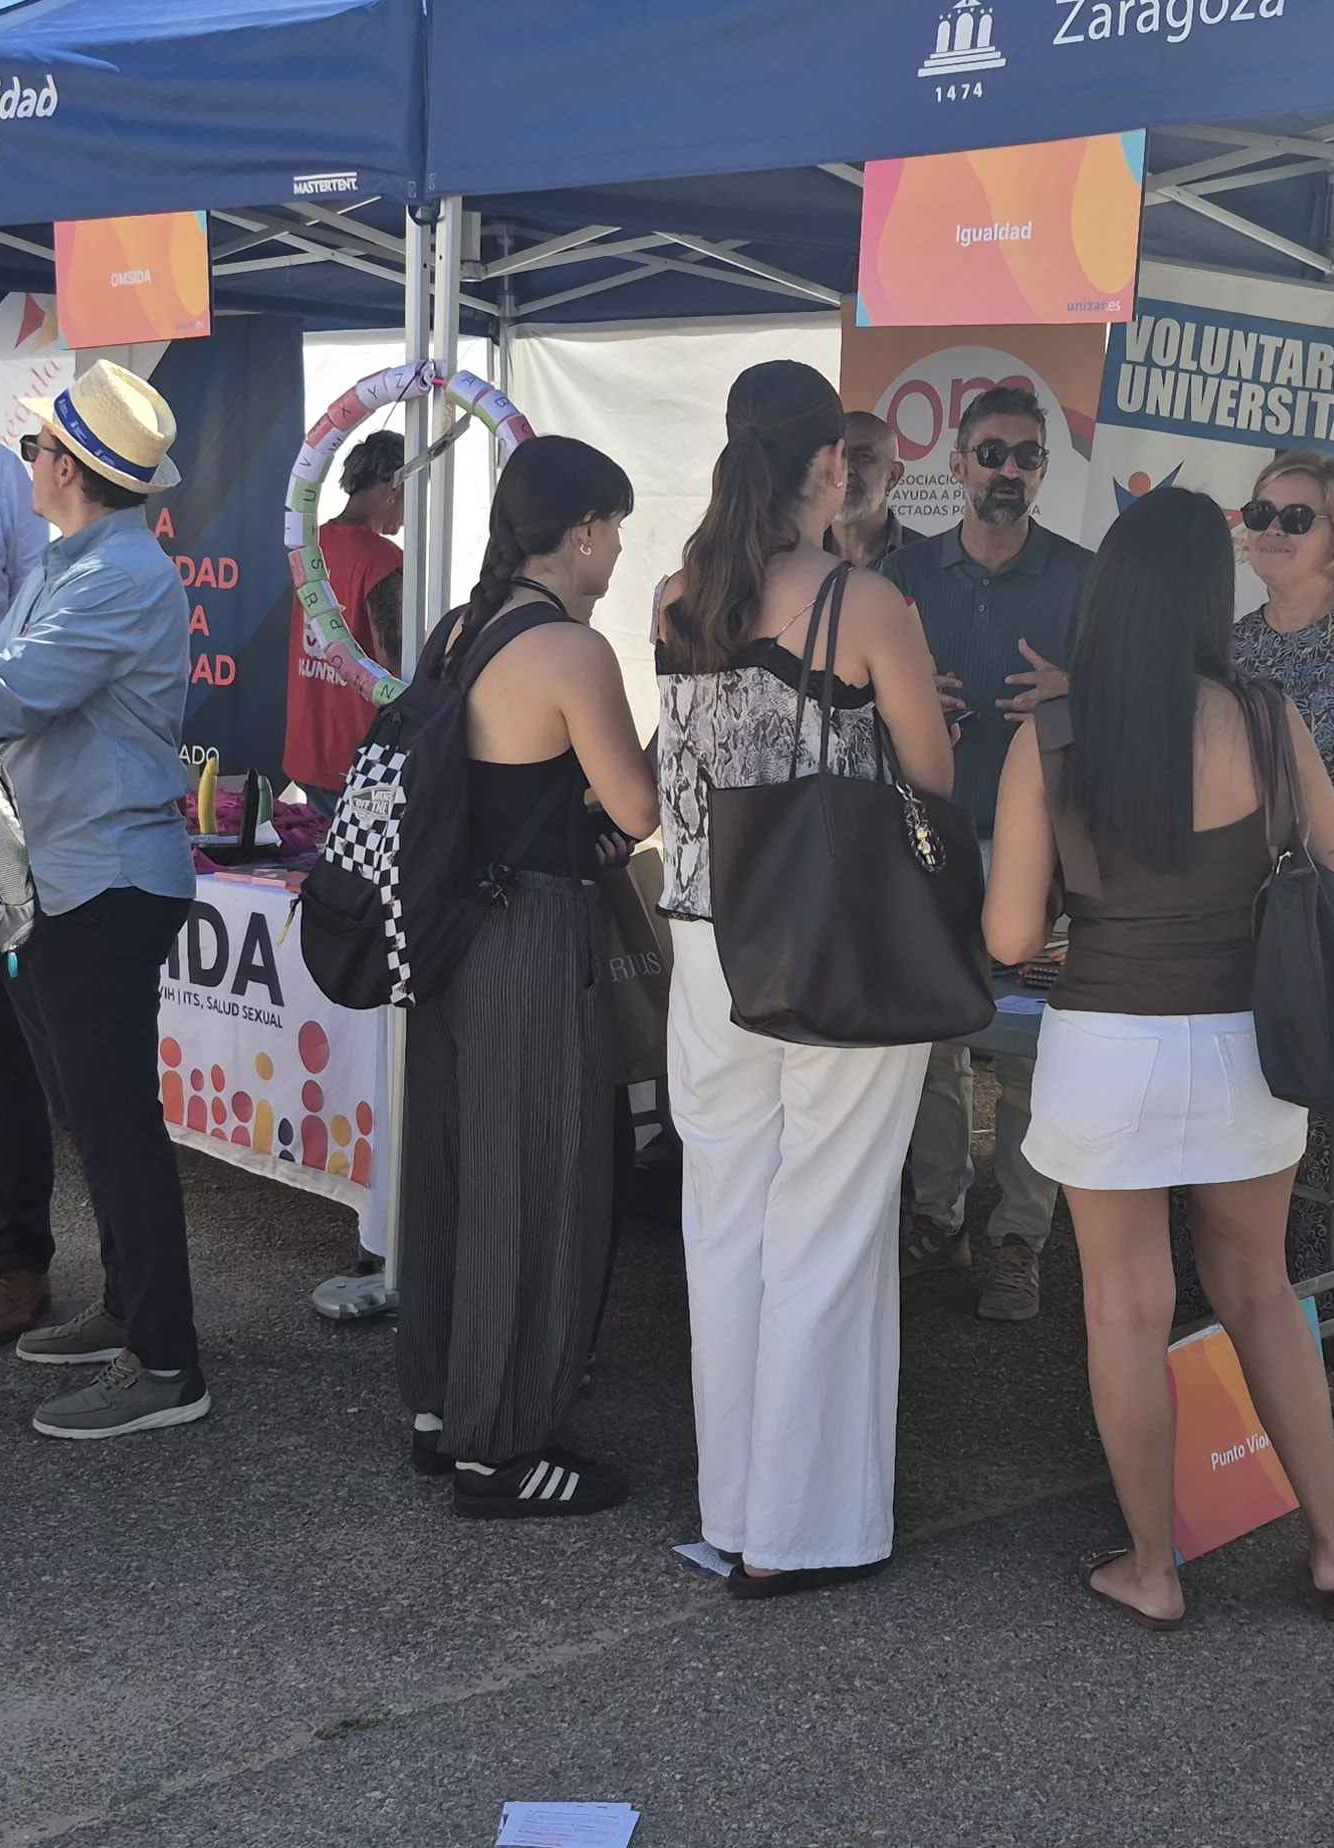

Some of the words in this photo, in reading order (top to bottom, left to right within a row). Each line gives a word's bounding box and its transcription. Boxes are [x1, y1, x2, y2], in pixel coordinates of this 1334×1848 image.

[1052, 0, 1285, 46] Zaragoza
[934, 82, 984, 103] 1474
[954, 221, 1034, 248] Igualdad
[110, 268, 152, 288] OMSIDA
[1066, 299, 1122, 313] unizar.es
[892, 489, 938, 501] AYUDA
[940, 490, 950, 501] A
[173, 555, 240, 590] DAD
[187, 653, 237, 686] AD
[206, 995, 240, 1018] SALUD
[241, 1004, 284, 1030] SEXUAL
[1210, 1442, 1246, 1472] Punto
